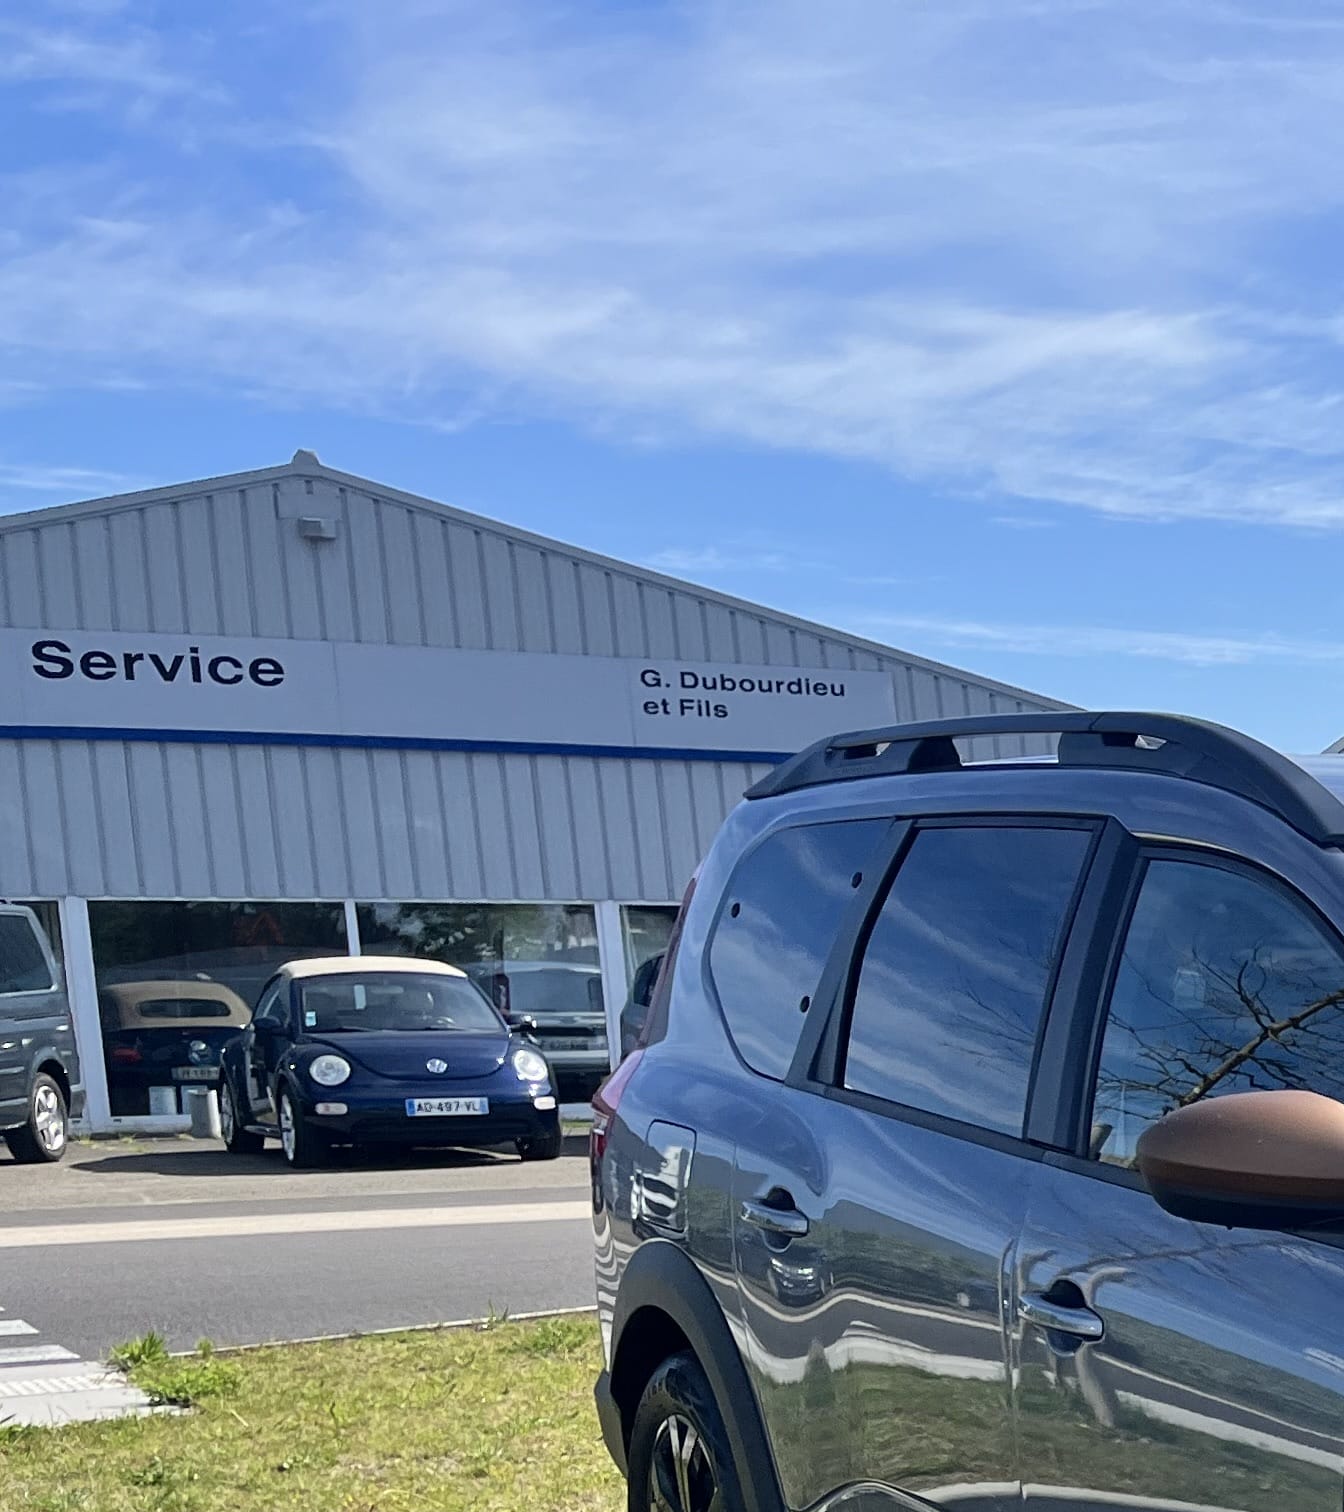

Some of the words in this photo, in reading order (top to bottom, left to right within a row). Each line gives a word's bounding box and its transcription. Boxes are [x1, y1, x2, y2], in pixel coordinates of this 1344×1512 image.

[31, 638, 286, 687] Service
[640, 668, 671, 689] G.
[679, 671, 847, 698] Dubourdieu
[643, 696, 671, 716] et
[679, 698, 729, 719] Fils
